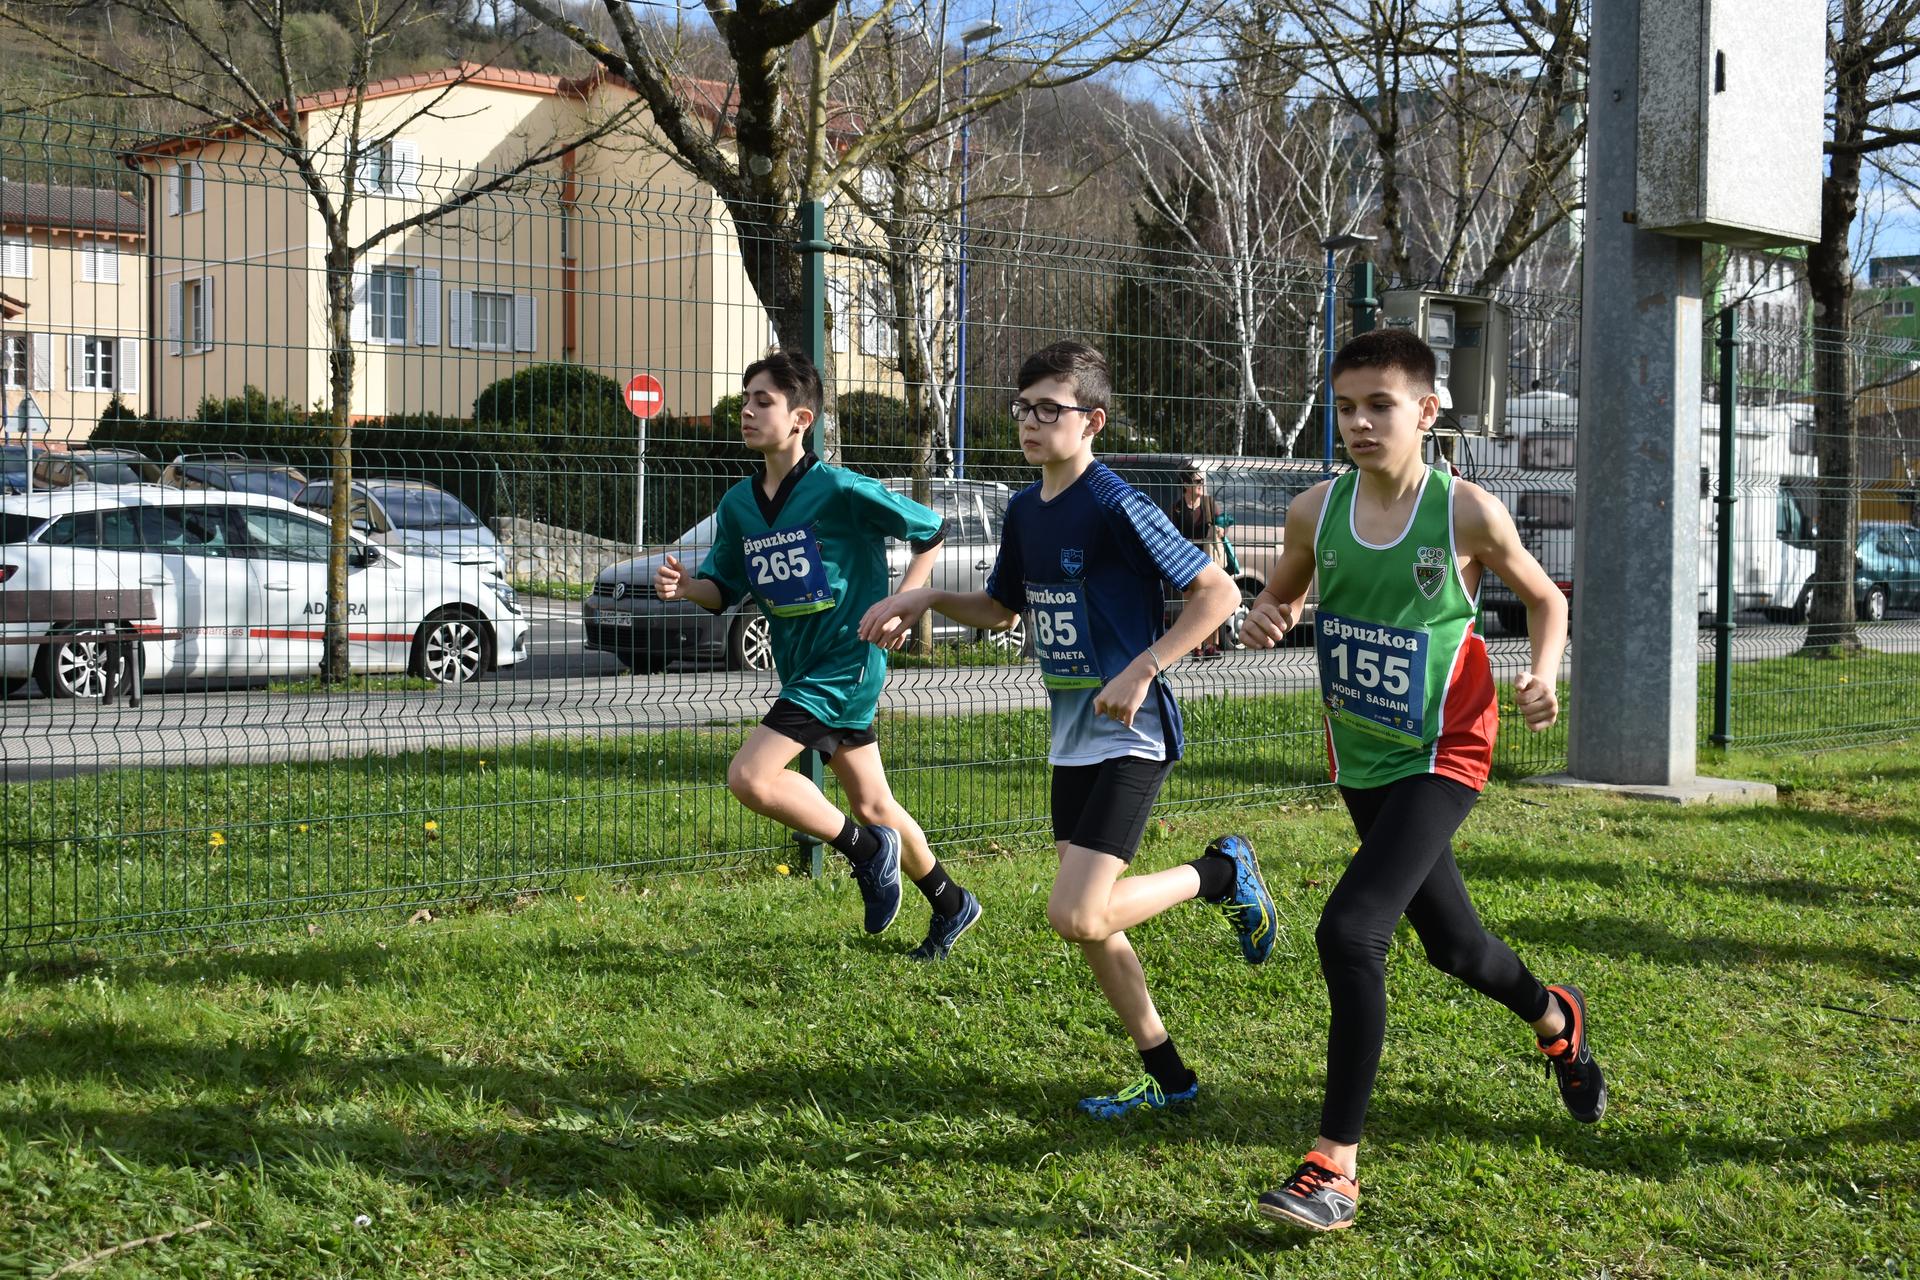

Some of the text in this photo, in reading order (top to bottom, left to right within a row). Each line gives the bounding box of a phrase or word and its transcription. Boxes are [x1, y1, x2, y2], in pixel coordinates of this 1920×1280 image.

[744, 530, 807, 555] gipuzkoa
[752, 547, 810, 584] 265
[303, 602, 368, 615] ADRA
[1323, 618, 1418, 652] gipuzkoa
[1053, 651, 1086, 660] IRAETA
[1331, 643, 1410, 696] 155
[1332, 682, 1408, 712] HODEI SASIAIN
